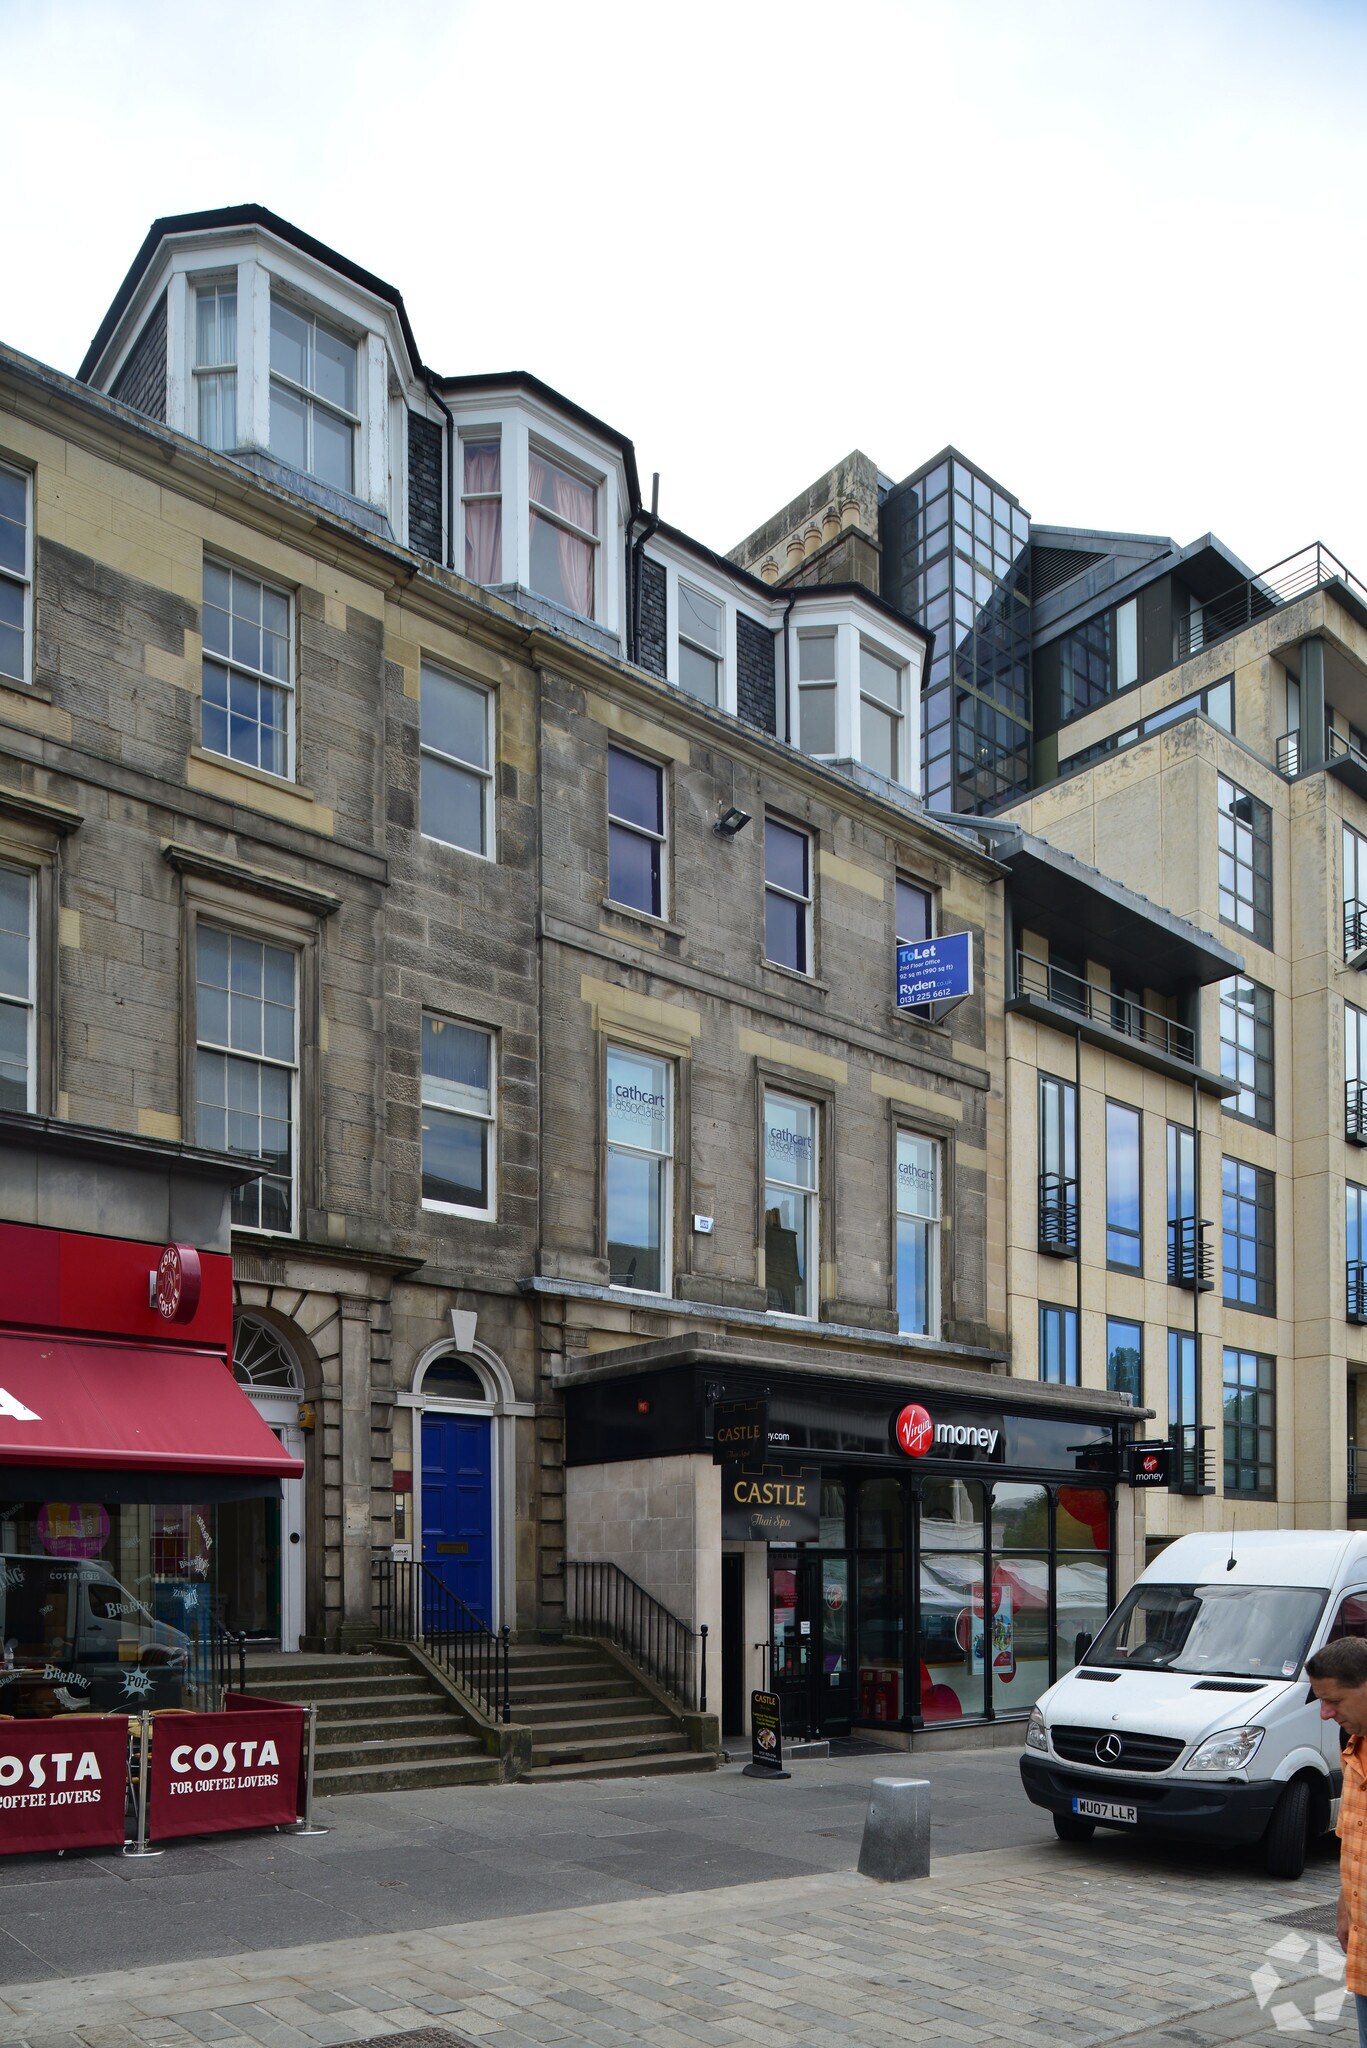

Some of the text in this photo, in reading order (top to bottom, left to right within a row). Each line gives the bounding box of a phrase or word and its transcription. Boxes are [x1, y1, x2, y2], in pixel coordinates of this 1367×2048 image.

[900, 958, 940, 971] 2nd Floor Office
[923, 967, 936, 975] (990
[900, 988, 951, 1004] 0131 225 6612
[615, 1085, 665, 1108] cathcart
[615, 1098, 666, 1122] associates
[771, 1127, 812, 1148] cathcart
[770, 1140, 813, 1161] associates
[898, 1163, 934, 1181] cathcart
[898, 1174, 935, 1192] associates
[160, 1251, 177, 1273] COSTA
[158, 1289, 179, 1314] COFFEE
[717, 1424, 760, 1442] CASTLE
[902, 1409, 999, 1454] Virgin money
[1143, 1456, 1157, 1471] Virgin
[1135, 1473, 1164, 1481] money
[734, 1481, 807, 1506] CASTLE
[751, 1513, 791, 1528] Thai Spa
[49, 1572, 79, 1581] COSTA
[127, 1675, 149, 1689] POP
[754, 1694, 776, 1706] CASTLE
[170, 1740, 279, 1773] COSTA
[170, 1773, 279, 1795] FOR COFFEE LOVERS
[49, 1789, 101, 1806] LOVERS
[1079, 1800, 1135, 1821] WU07 LLR
